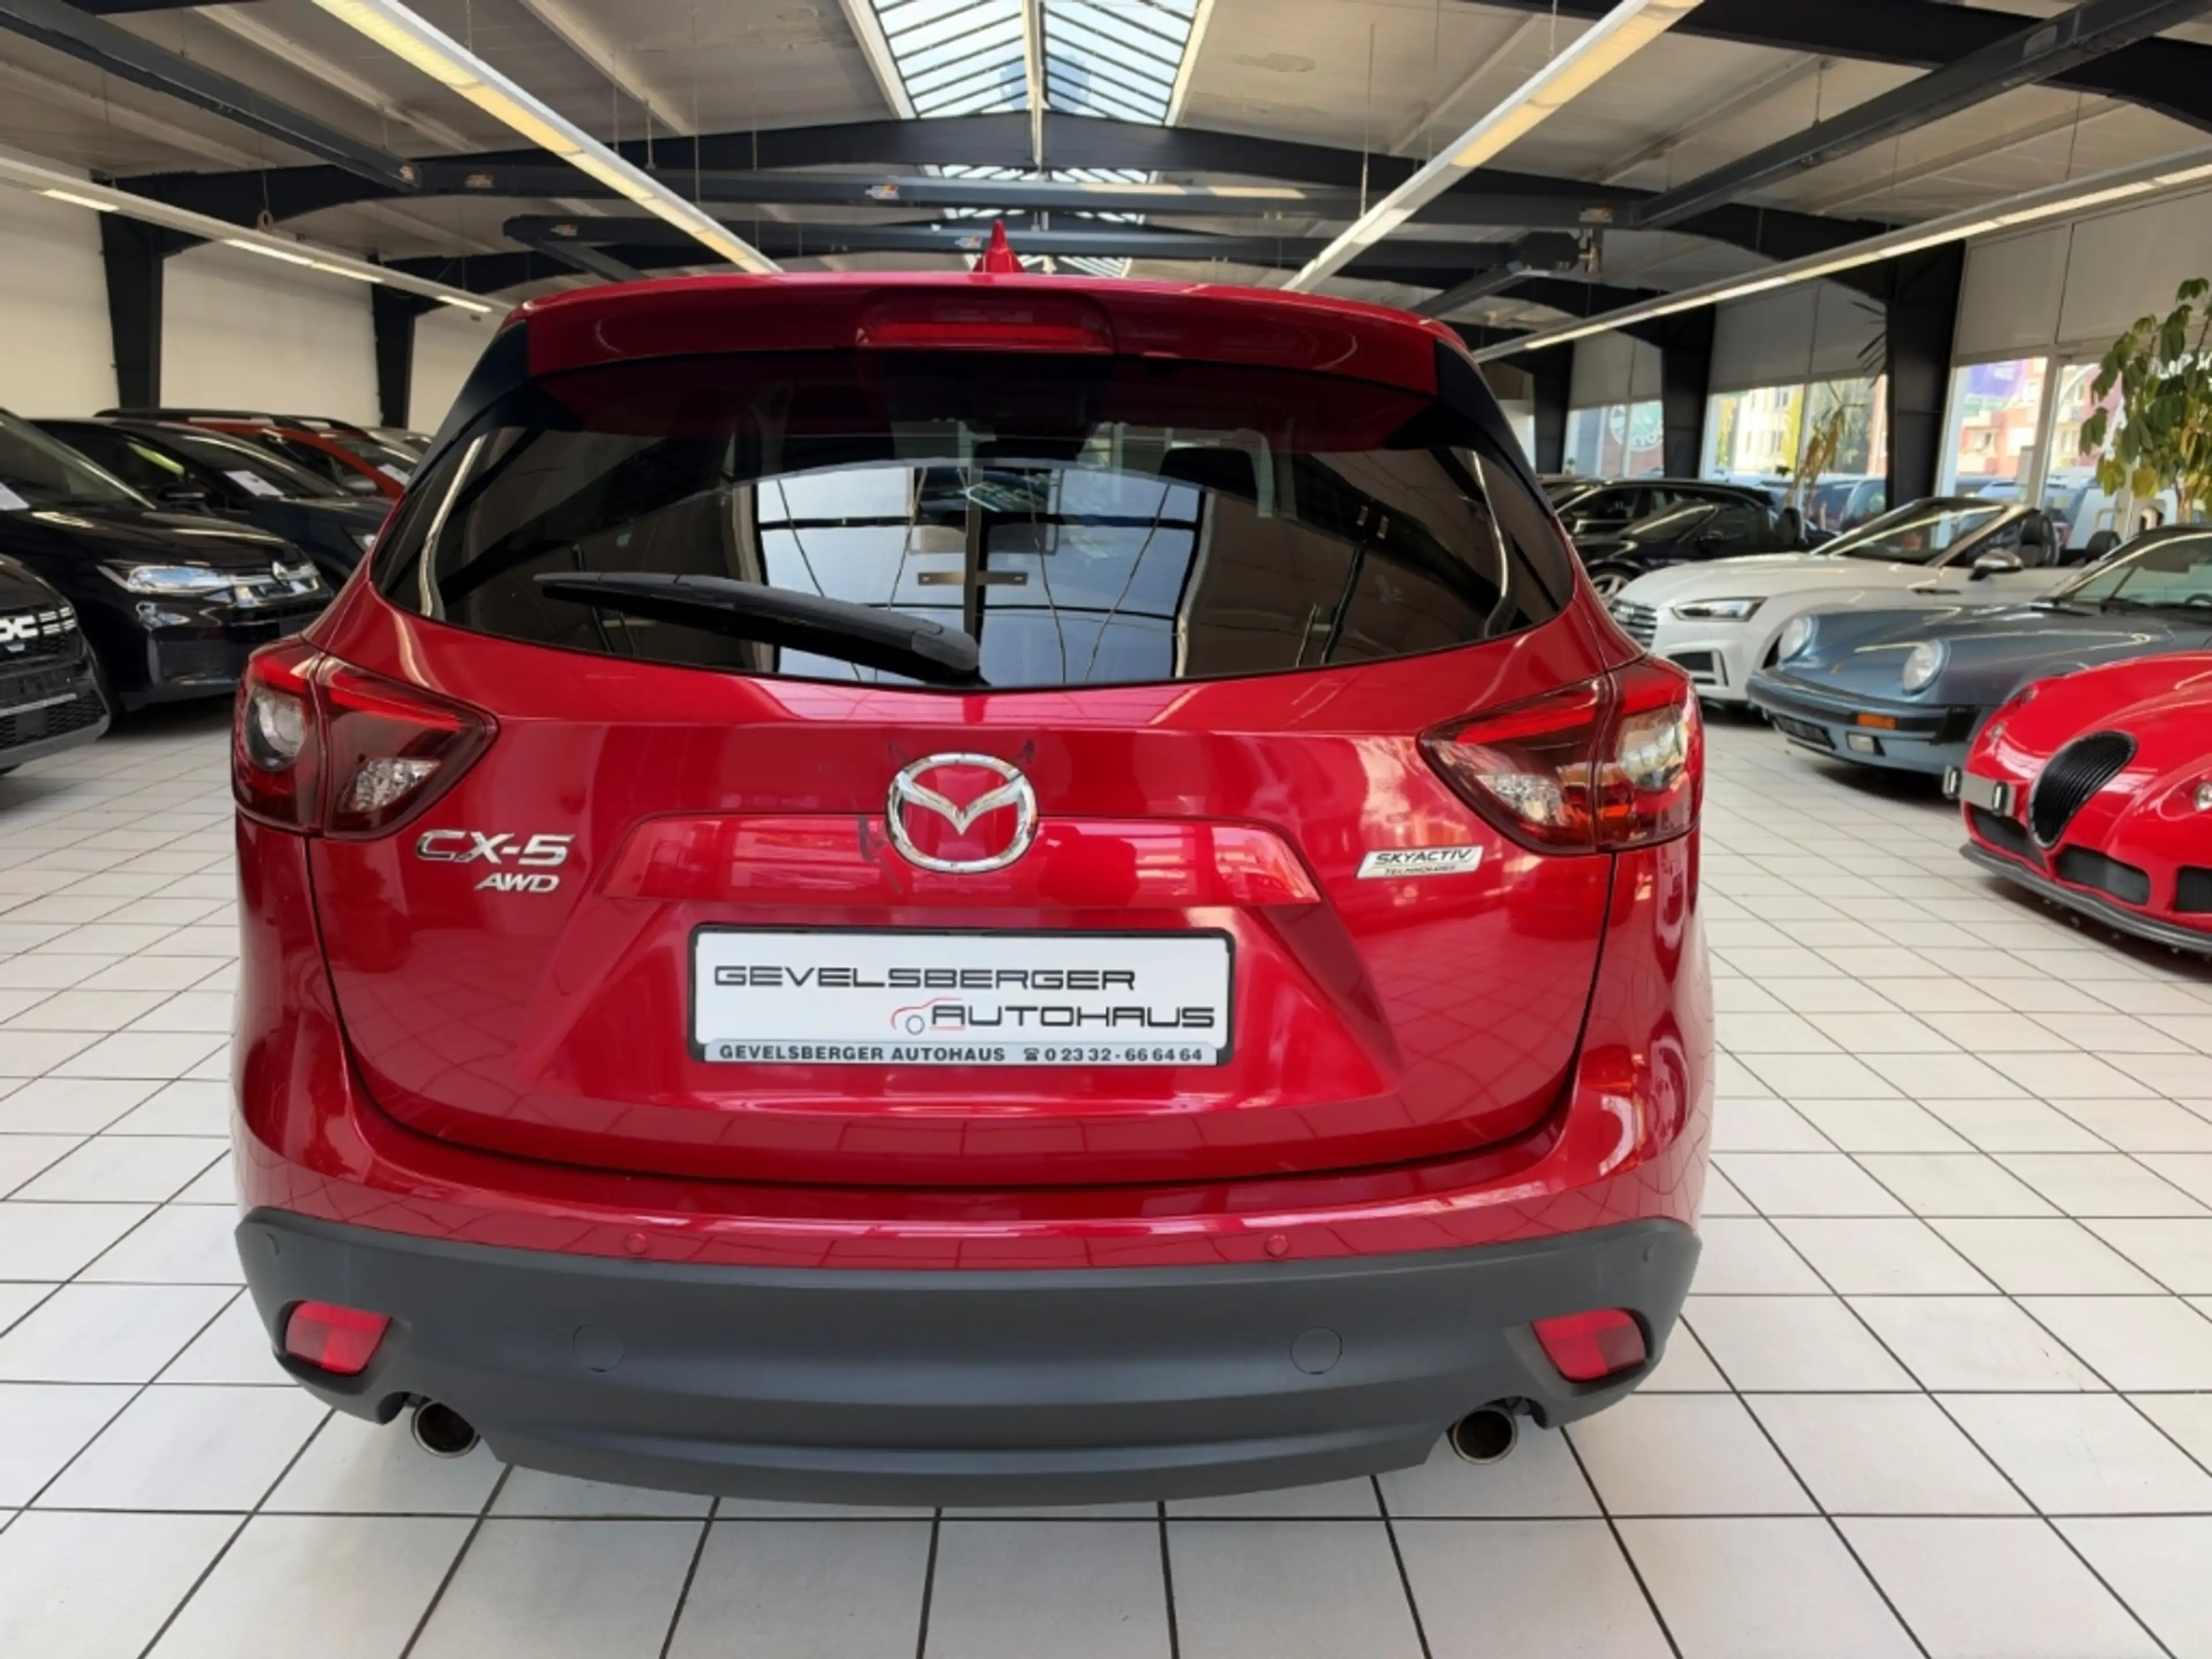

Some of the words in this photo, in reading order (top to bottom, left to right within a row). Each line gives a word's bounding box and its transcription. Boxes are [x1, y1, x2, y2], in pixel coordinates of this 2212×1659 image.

[415, 828, 575, 866] CX-5
[1376, 849, 1472, 863] SKYACTIV
[474, 872, 559, 893] AWD
[714, 965, 1135, 990] GEVELSBERGER
[931, 1005, 1215, 1028] AUTOHAUS
[719, 1044, 884, 1060] GEVELSBERGER
[891, 1047, 1005, 1061] AUTOHAUS
